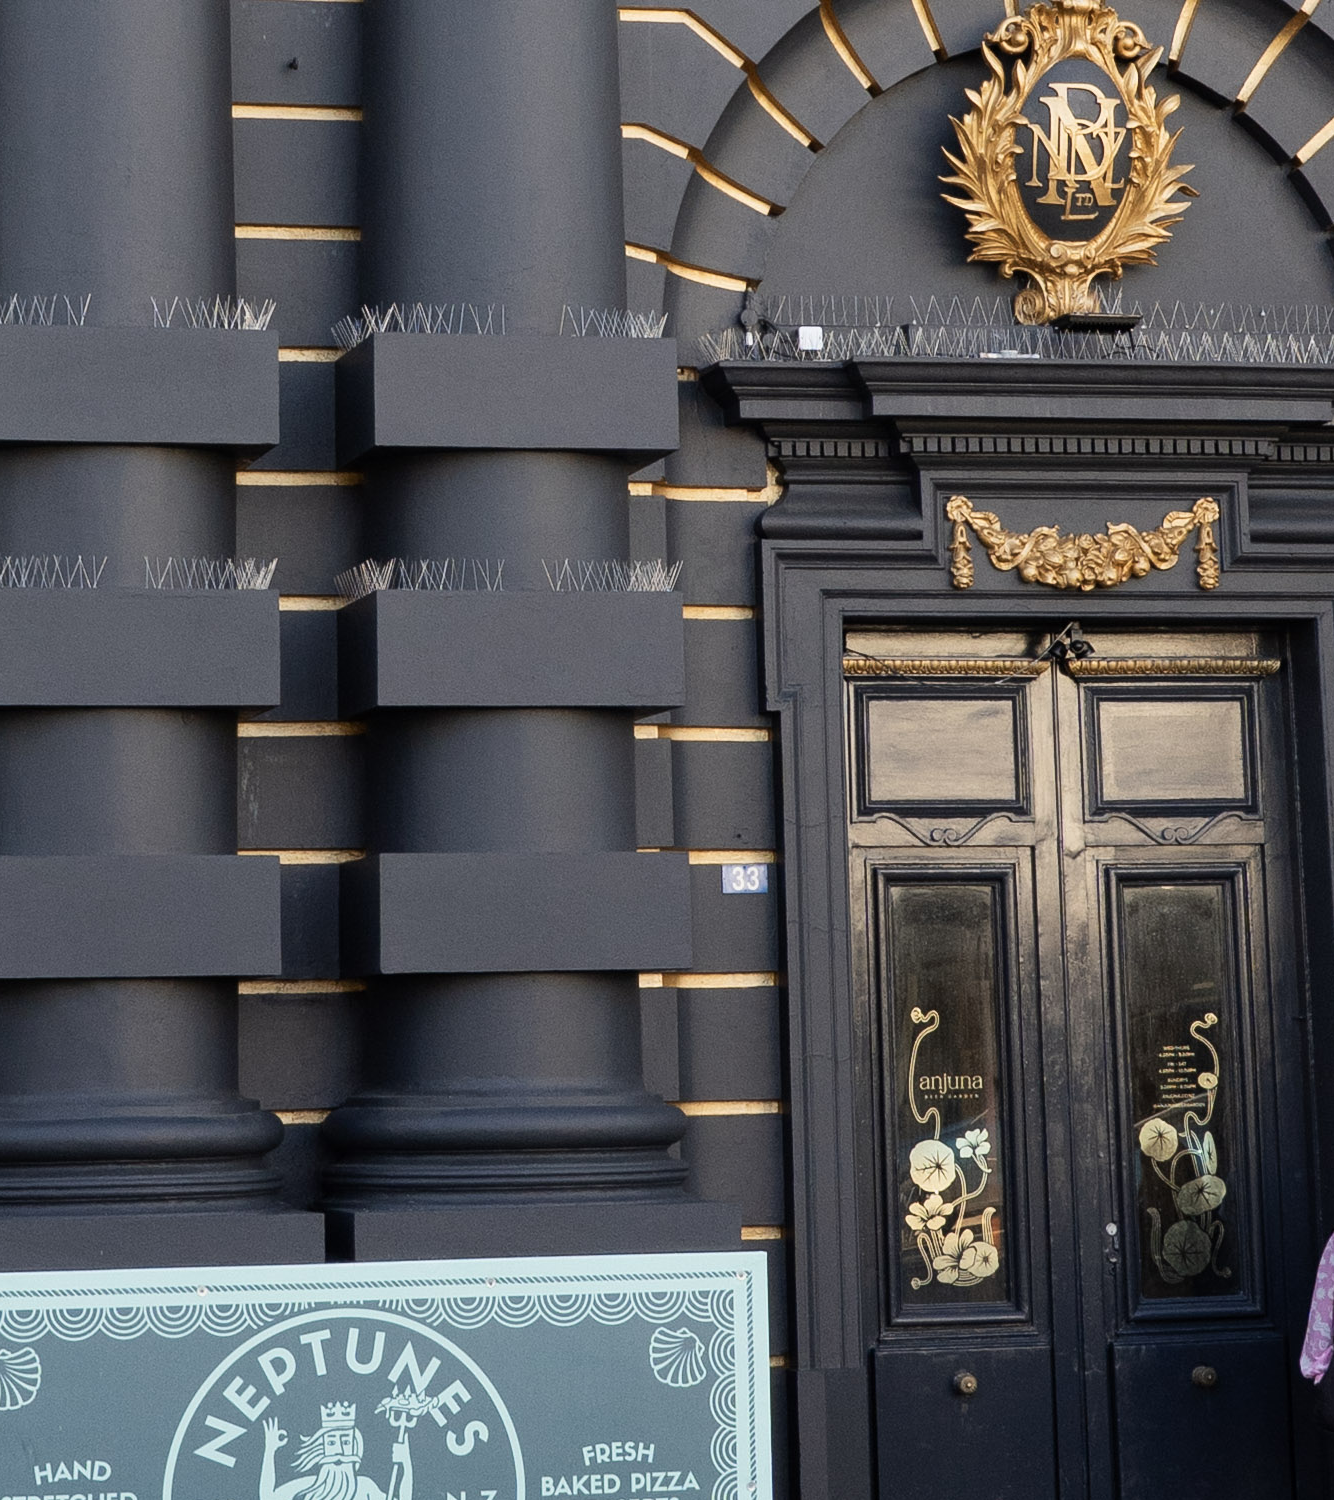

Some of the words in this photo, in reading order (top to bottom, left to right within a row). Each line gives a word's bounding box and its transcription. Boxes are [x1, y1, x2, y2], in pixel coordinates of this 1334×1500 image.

[732, 866, 760, 891] 33
[919, 1073, 983, 1094] anjuna
[193, 1328, 489, 1468] NEPTUNES
[582, 1441, 655, 1466] FRESH
[34, 1460, 112, 1485] HAND
[541, 1474, 621, 1497] BAKED
[631, 1471, 700, 1493] PIZZA
